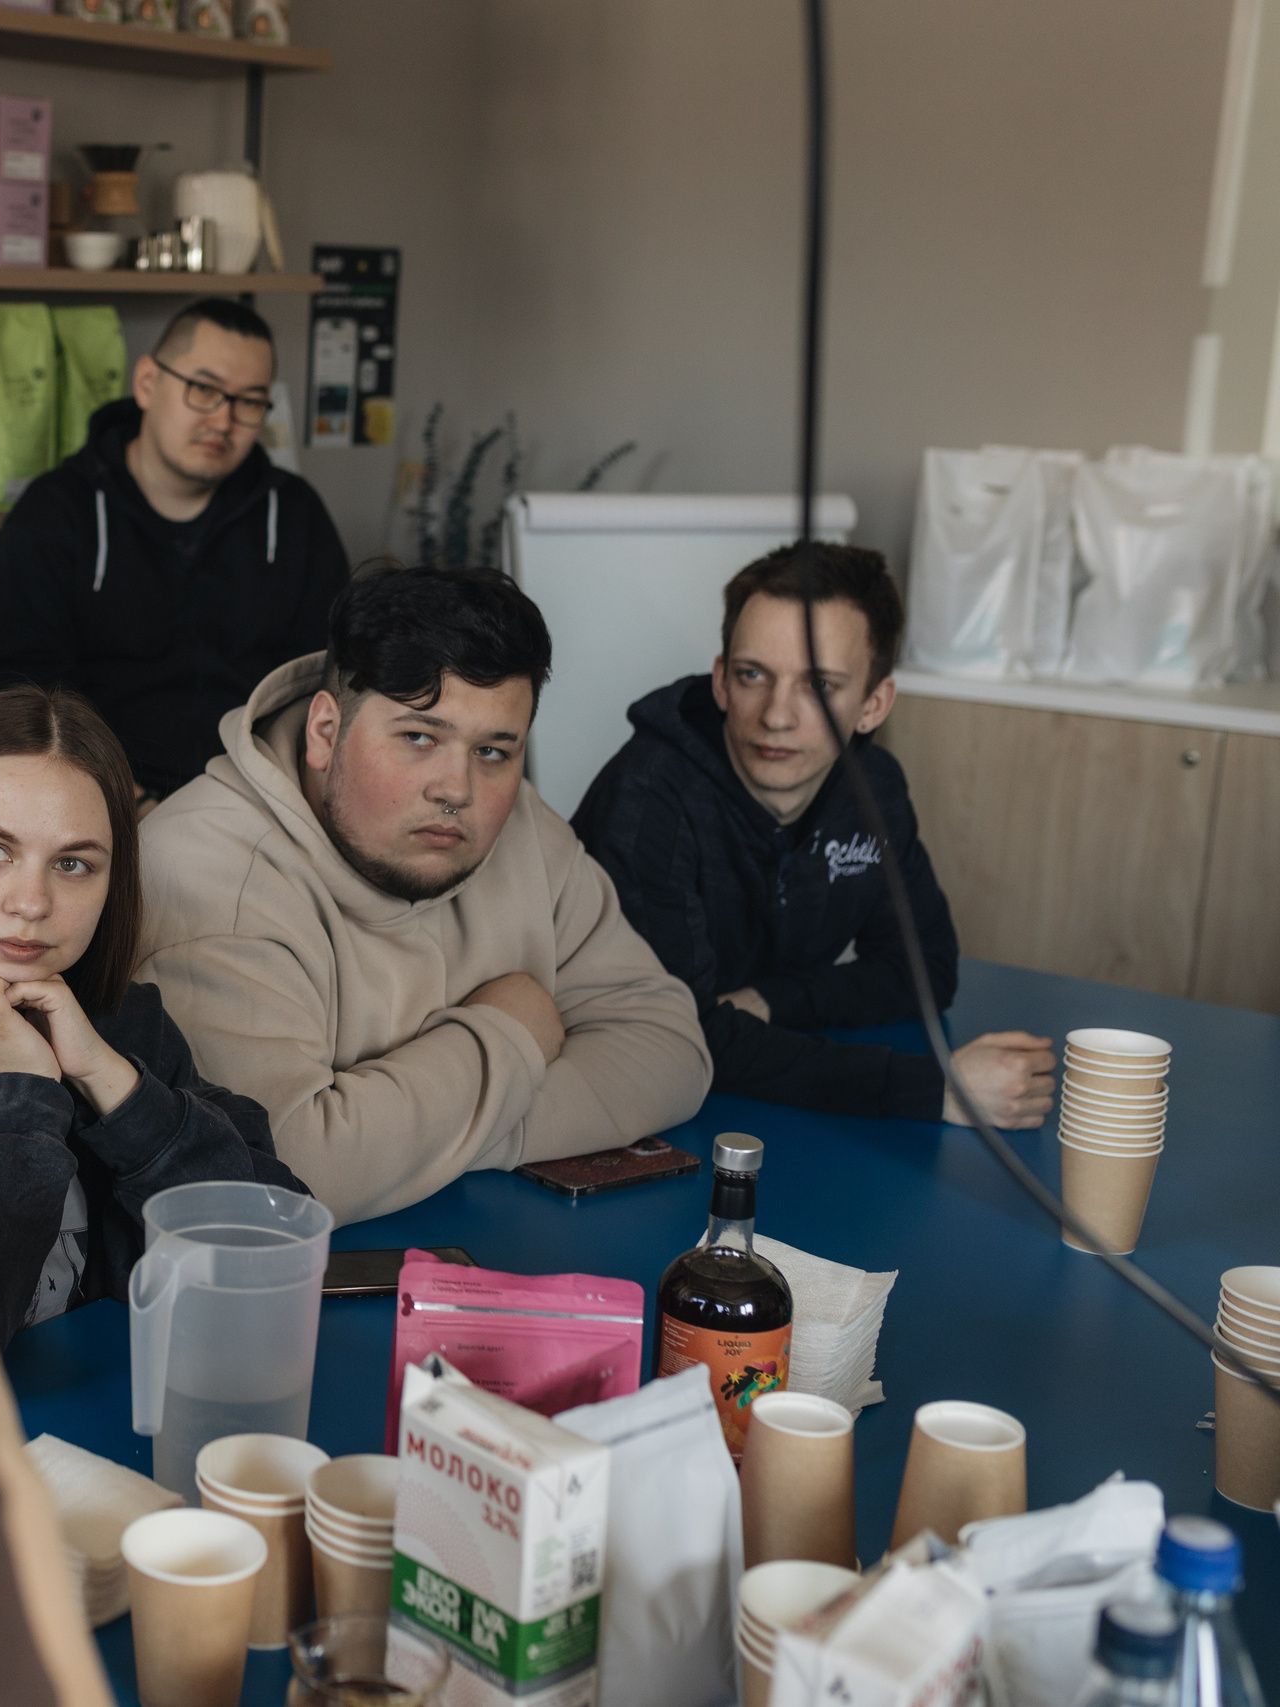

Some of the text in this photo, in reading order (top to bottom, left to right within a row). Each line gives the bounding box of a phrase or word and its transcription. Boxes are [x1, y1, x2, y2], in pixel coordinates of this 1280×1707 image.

[717, 1339, 752, 1350] LIQUID
[724, 1348, 742, 1357] JOY
[406, 1429, 522, 1514] МОЛОКО
